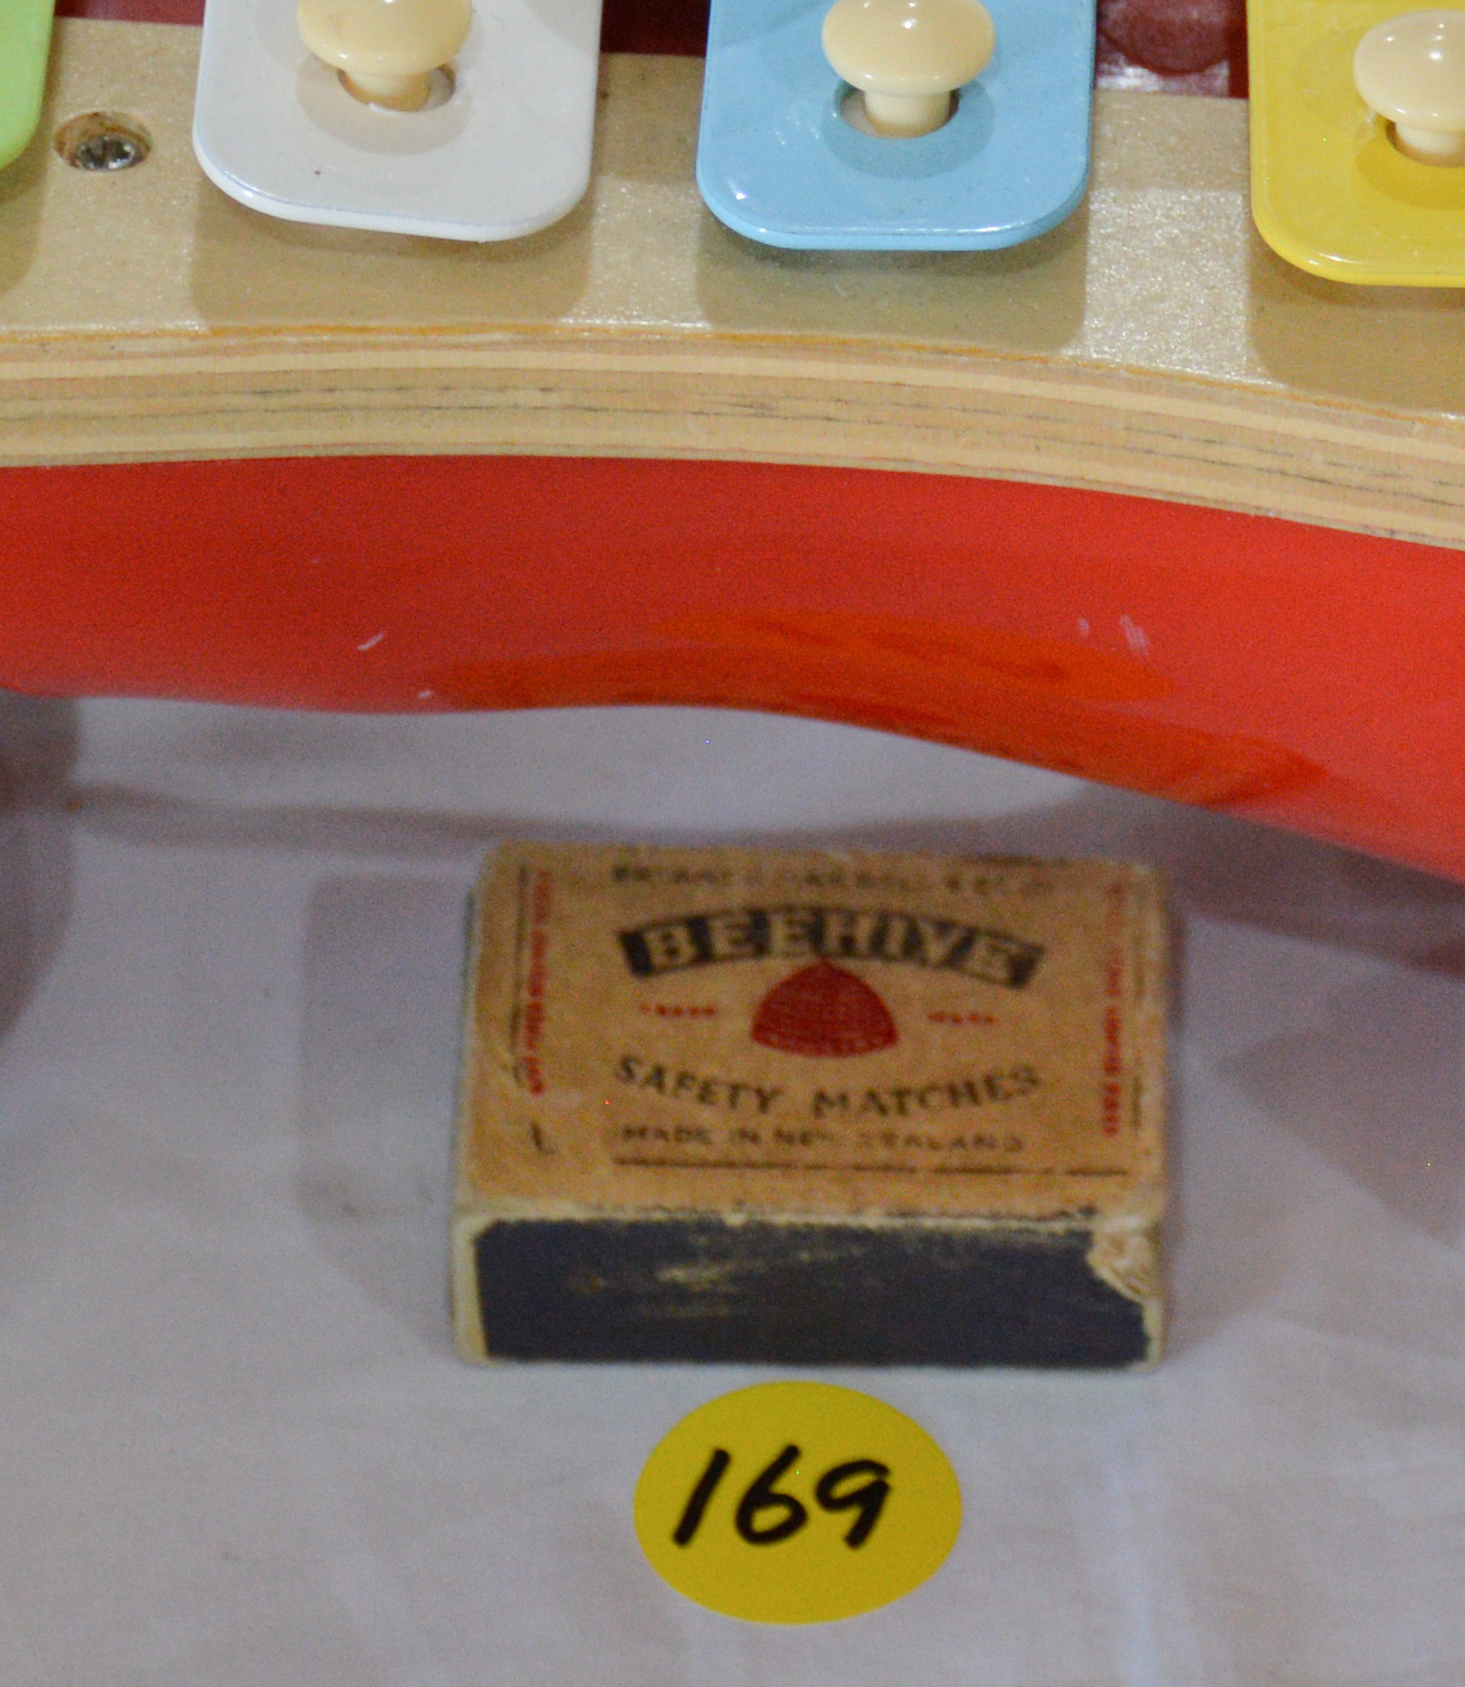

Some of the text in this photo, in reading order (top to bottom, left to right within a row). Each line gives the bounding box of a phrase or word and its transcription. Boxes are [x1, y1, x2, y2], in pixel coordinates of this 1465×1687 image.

[639, 909, 1021, 984] BEEHIVE
[613, 1053, 1041, 1120] SAFETY MATCHES
[671, 1443, 892, 1551] 169
